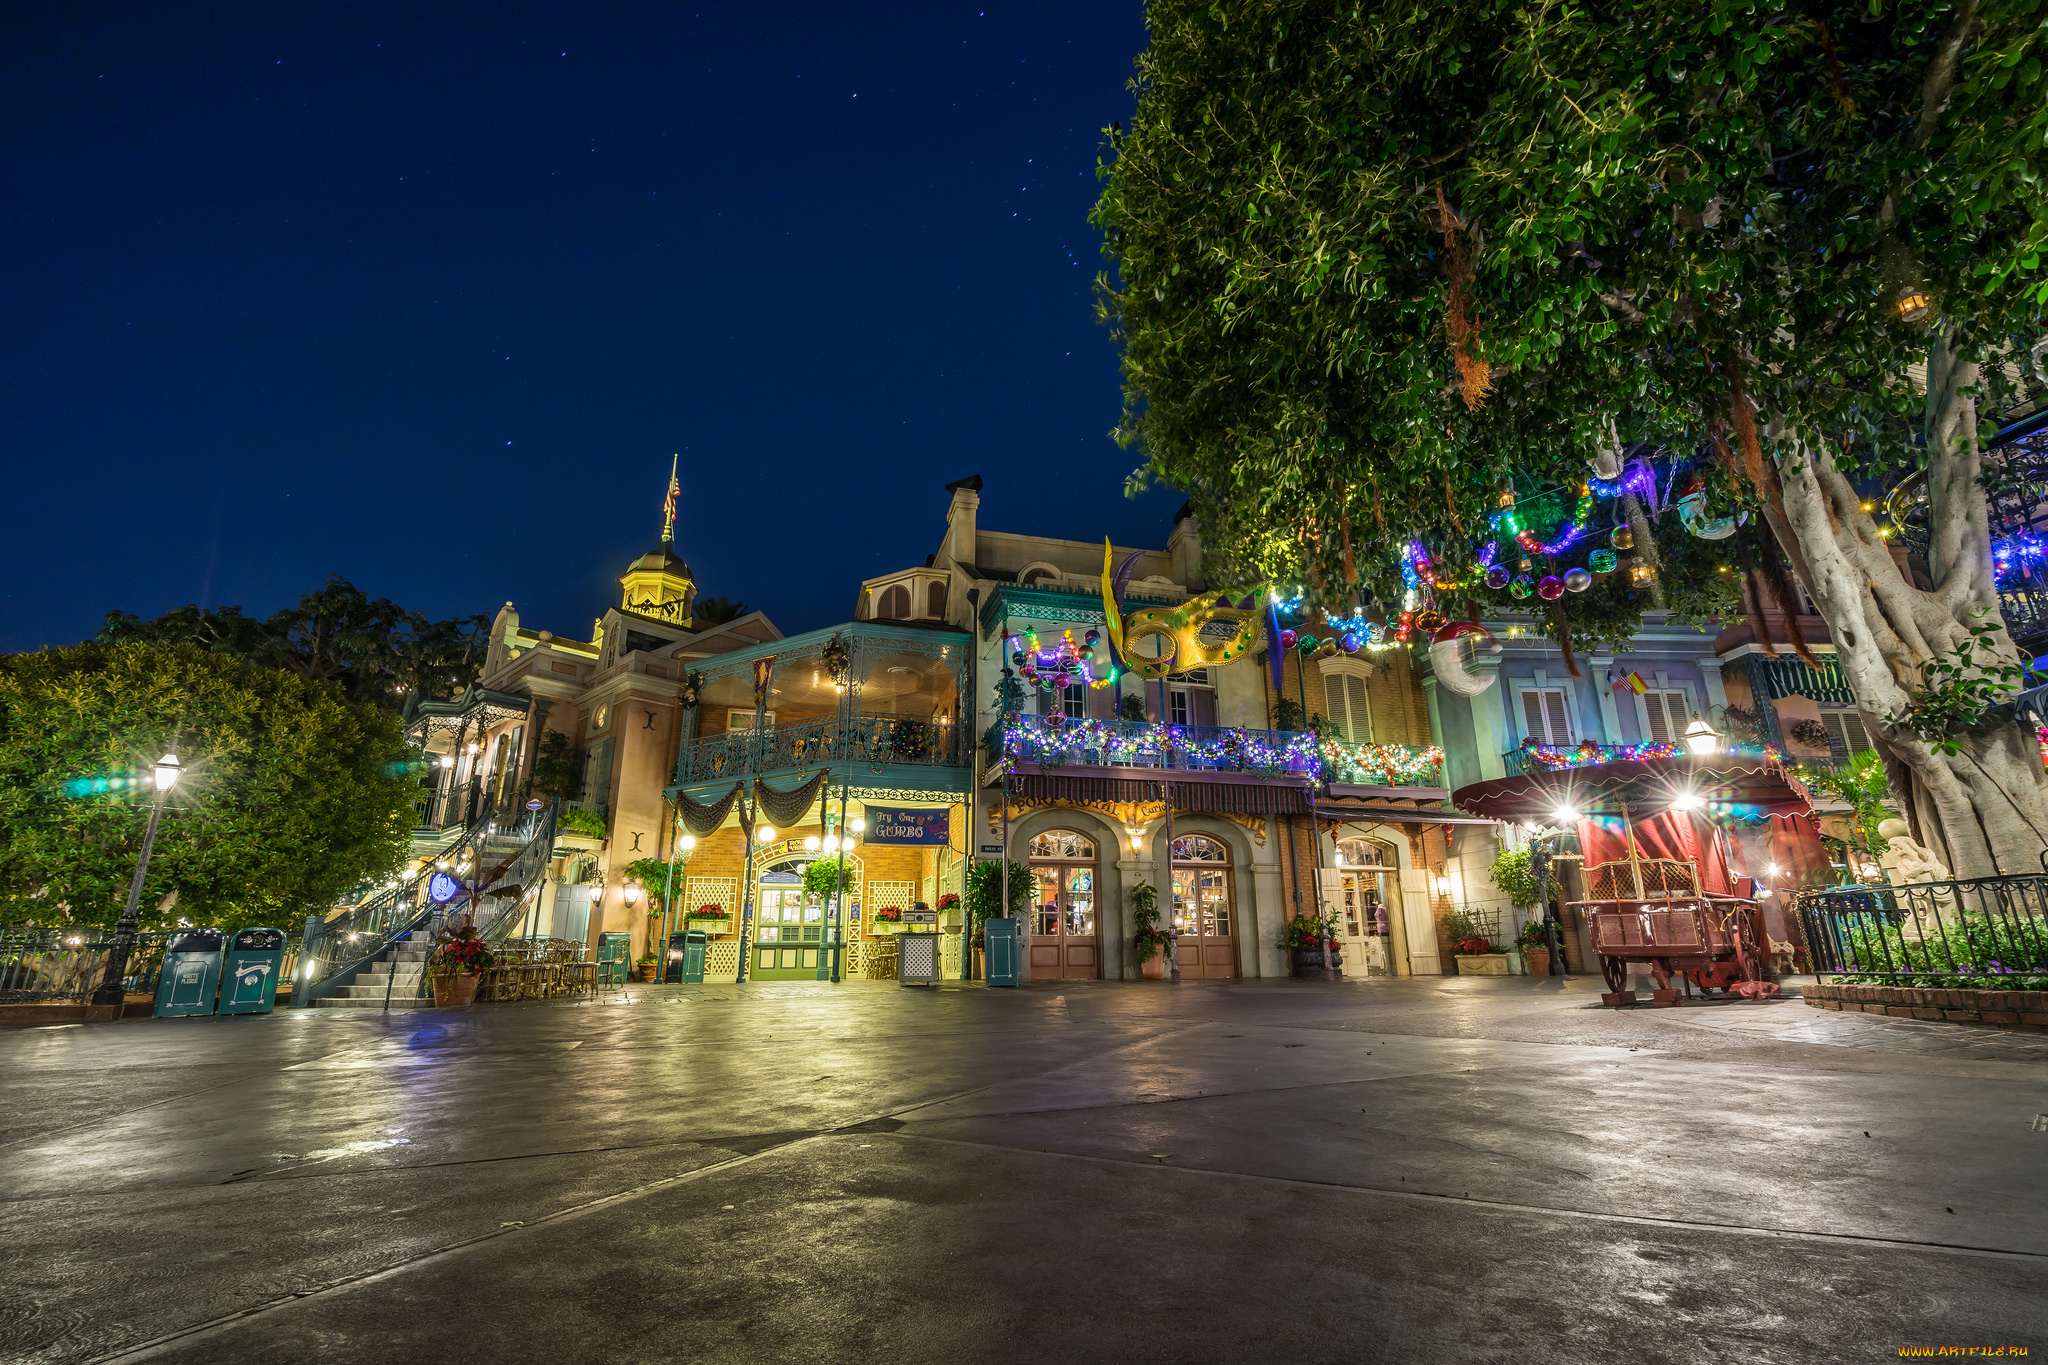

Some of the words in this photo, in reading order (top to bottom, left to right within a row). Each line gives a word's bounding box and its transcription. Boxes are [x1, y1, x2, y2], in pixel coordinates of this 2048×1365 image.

[876, 811, 892, 823] Try
[899, 811, 915, 823] Our
[1141, 803, 1168, 817] Curio
[876, 824, 924, 838] GUMBO
